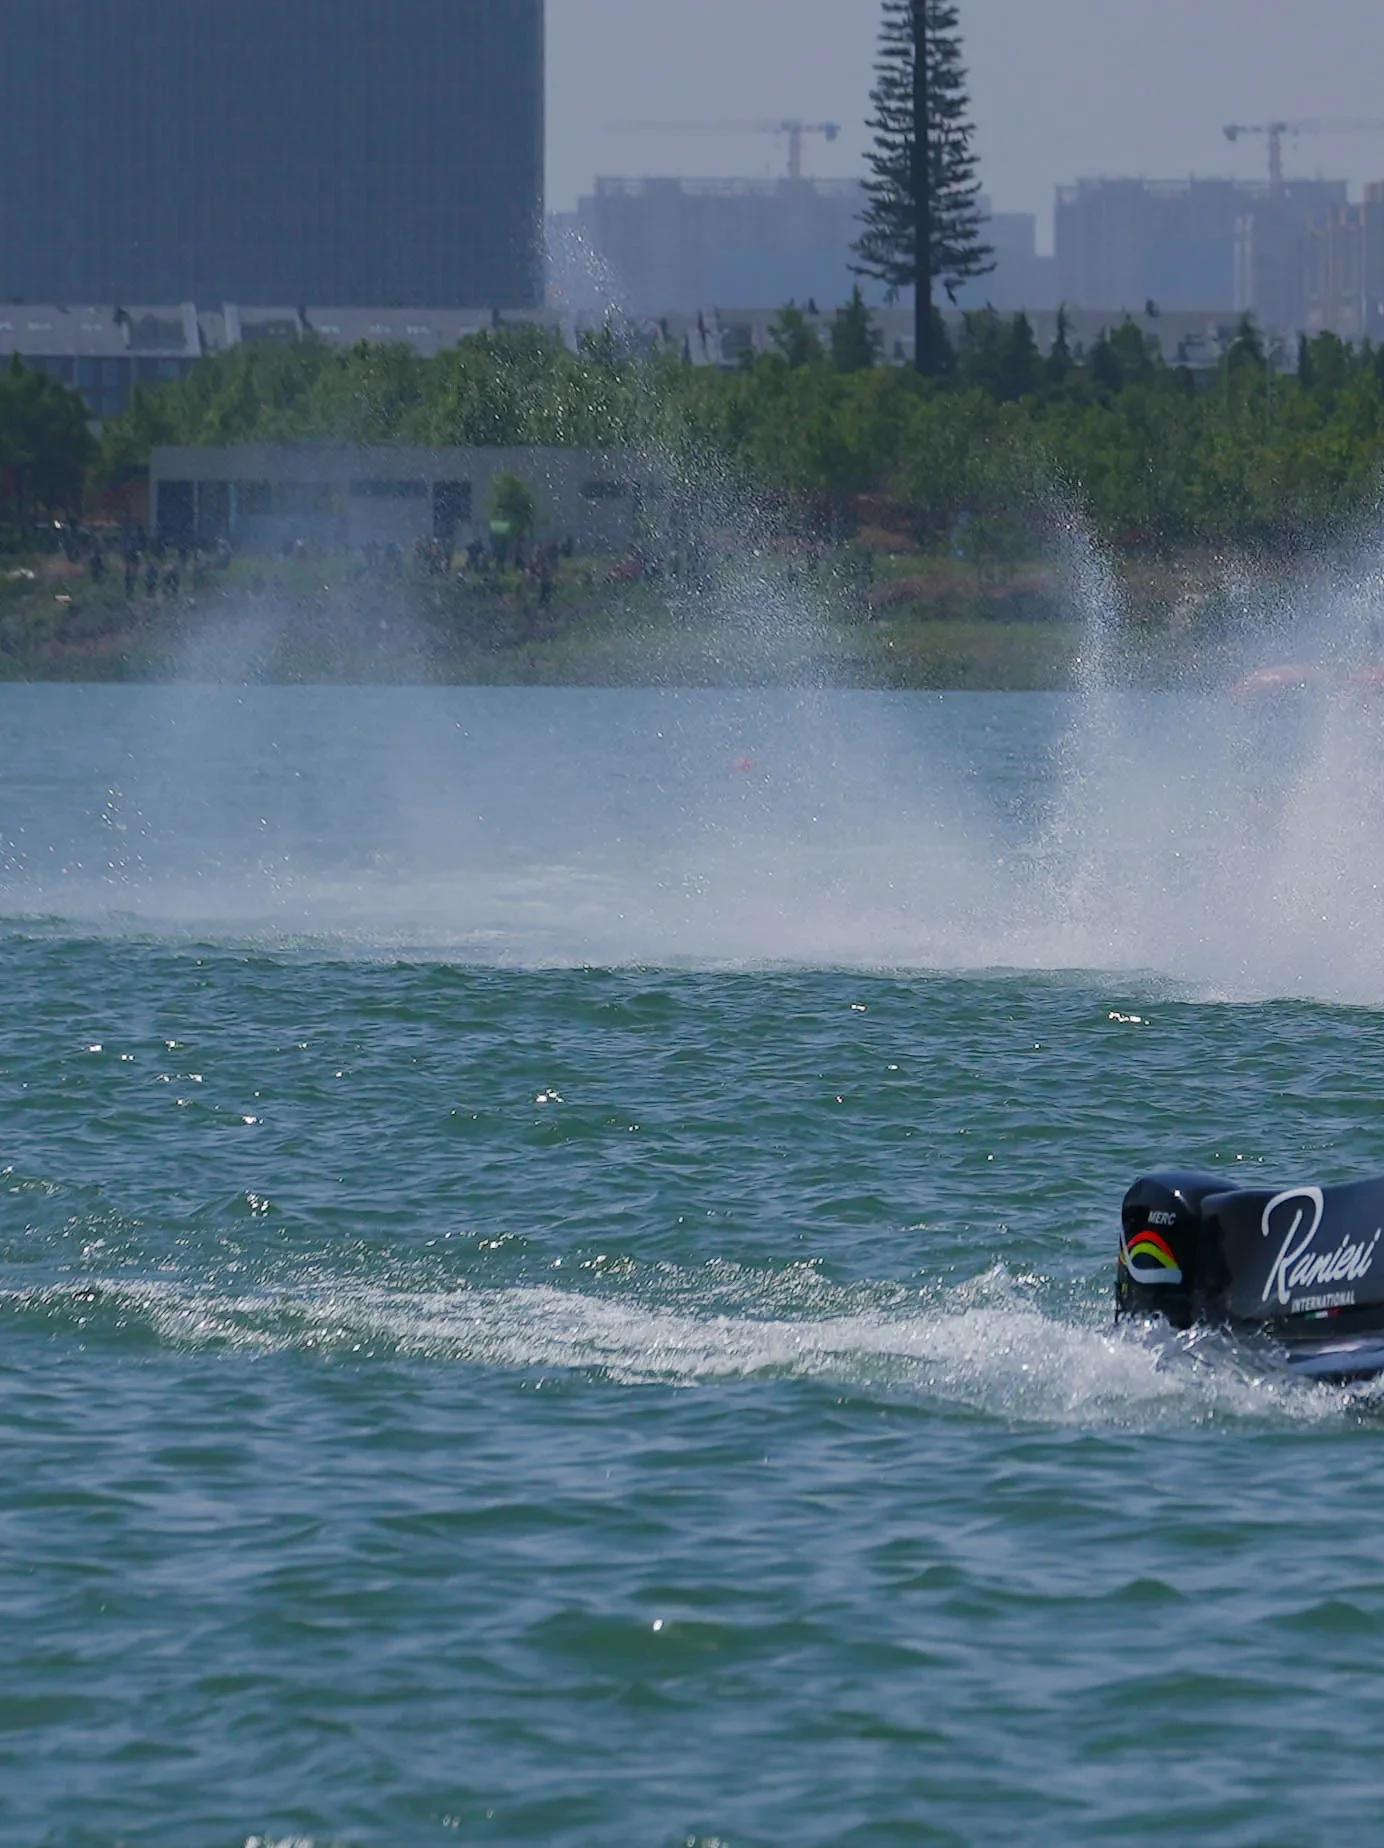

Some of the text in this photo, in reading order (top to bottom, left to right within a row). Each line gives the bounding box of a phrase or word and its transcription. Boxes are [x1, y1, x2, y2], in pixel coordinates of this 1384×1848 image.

[1147, 1210, 1177, 1226] MERC
[1261, 1186, 1381, 1305] Ranieri
[1291, 1290, 1356, 1313] INTERNATIONAL
